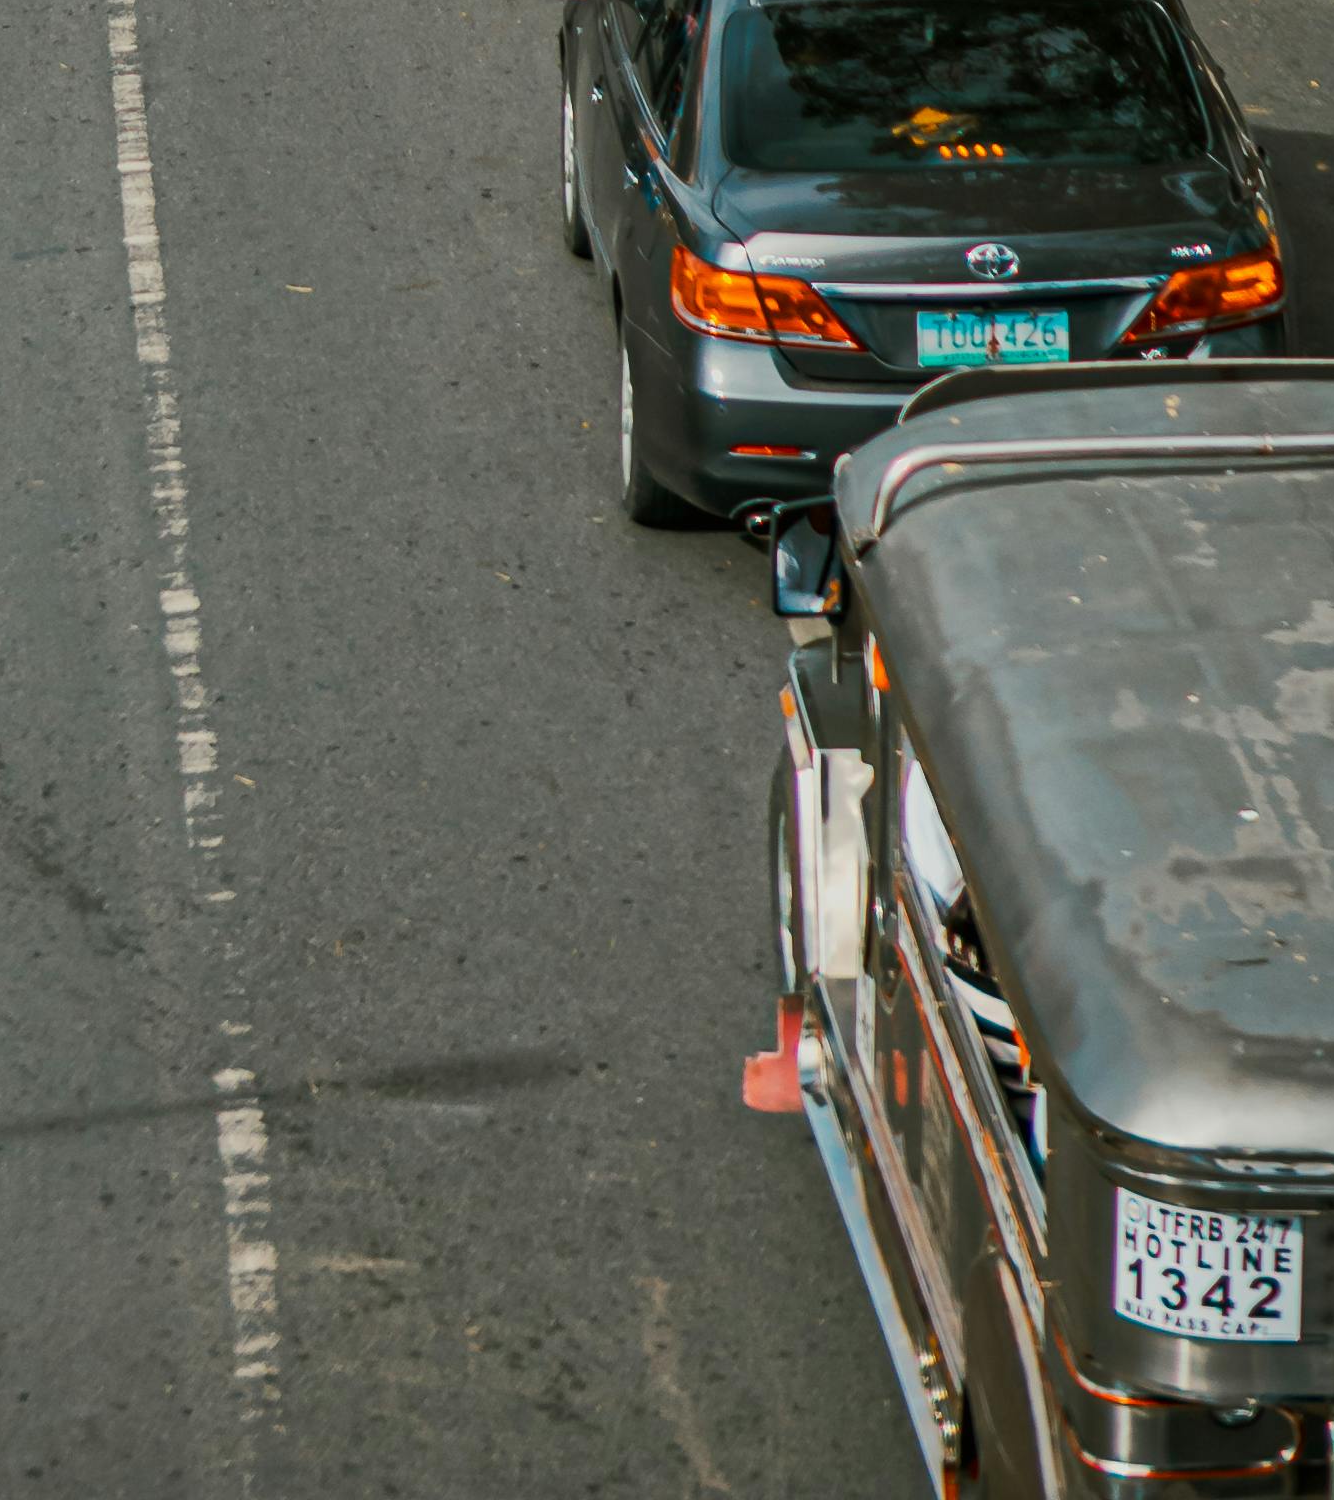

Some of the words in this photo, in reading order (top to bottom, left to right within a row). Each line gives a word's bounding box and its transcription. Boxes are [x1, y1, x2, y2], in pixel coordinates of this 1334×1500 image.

[1004, 317, 1057, 347] 426
[1145, 1204, 1224, 1242] LTFRB
[1123, 1224, 1293, 1274] HOTLINE
[1128, 1257, 1283, 1320] 1342
